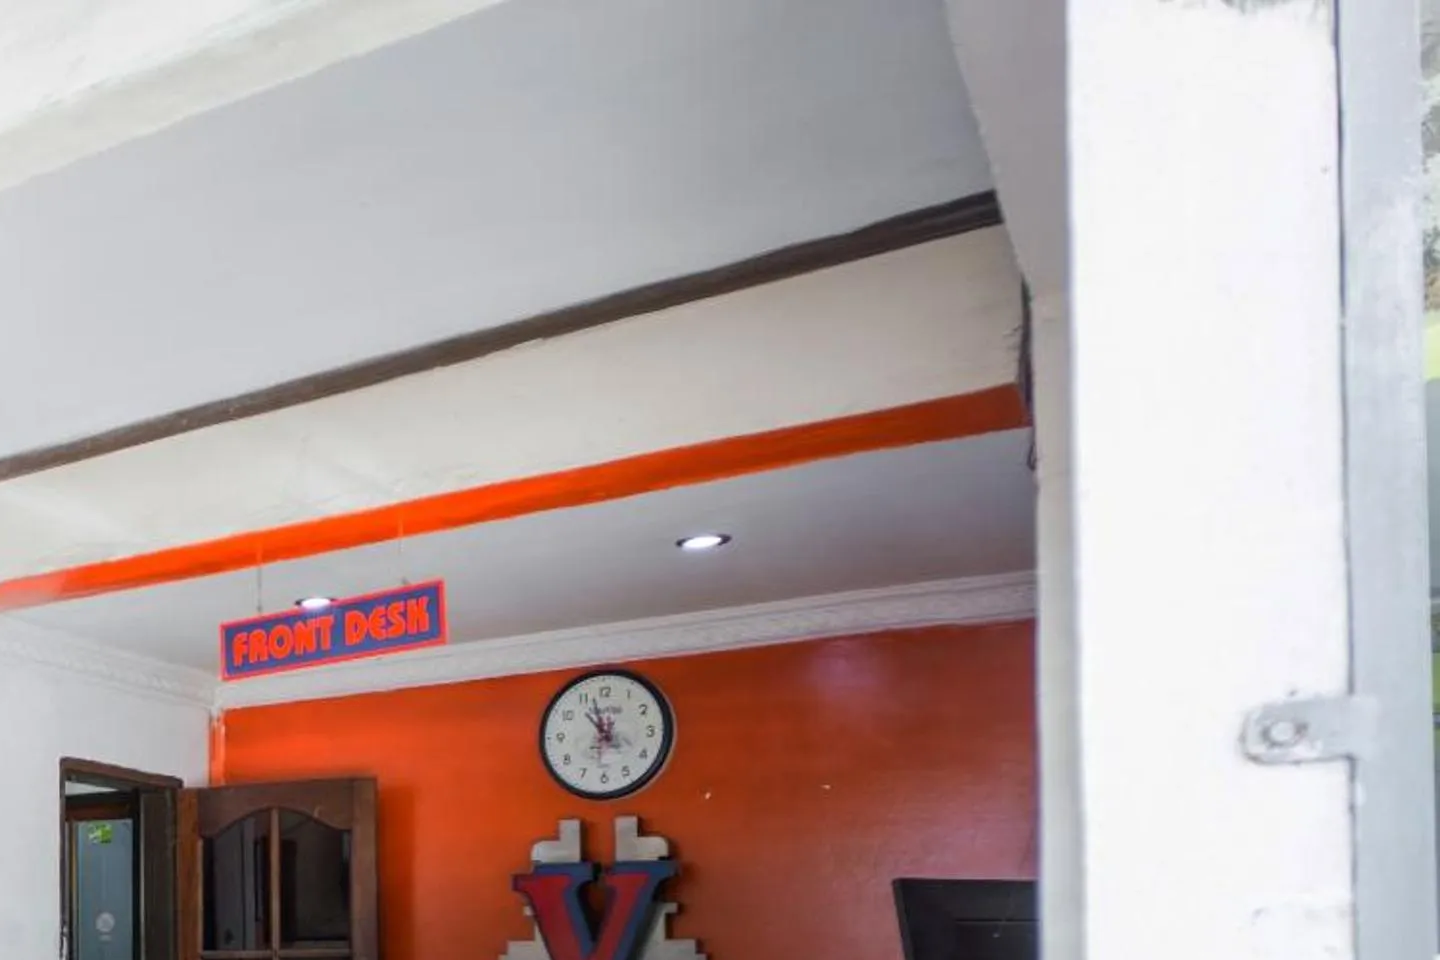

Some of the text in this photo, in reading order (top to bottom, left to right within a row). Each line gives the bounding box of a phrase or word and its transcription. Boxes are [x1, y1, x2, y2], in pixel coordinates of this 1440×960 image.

[231, 596, 430, 667] FRONT DESK
[599, 686, 611, 698] 12
[626, 689, 631, 700] 1
[579, 693, 588, 704] 11
[562, 710, 574, 721] 10
[638, 704, 648, 716] 2
[646, 725, 655, 738] 3
[556, 732, 566, 743] 9
[563, 753, 571, 765] 8
[638, 748, 648, 759] 4
[579, 768, 587, 779] 7
[621, 766, 631, 777] 5
[600, 772, 609, 784] 6
